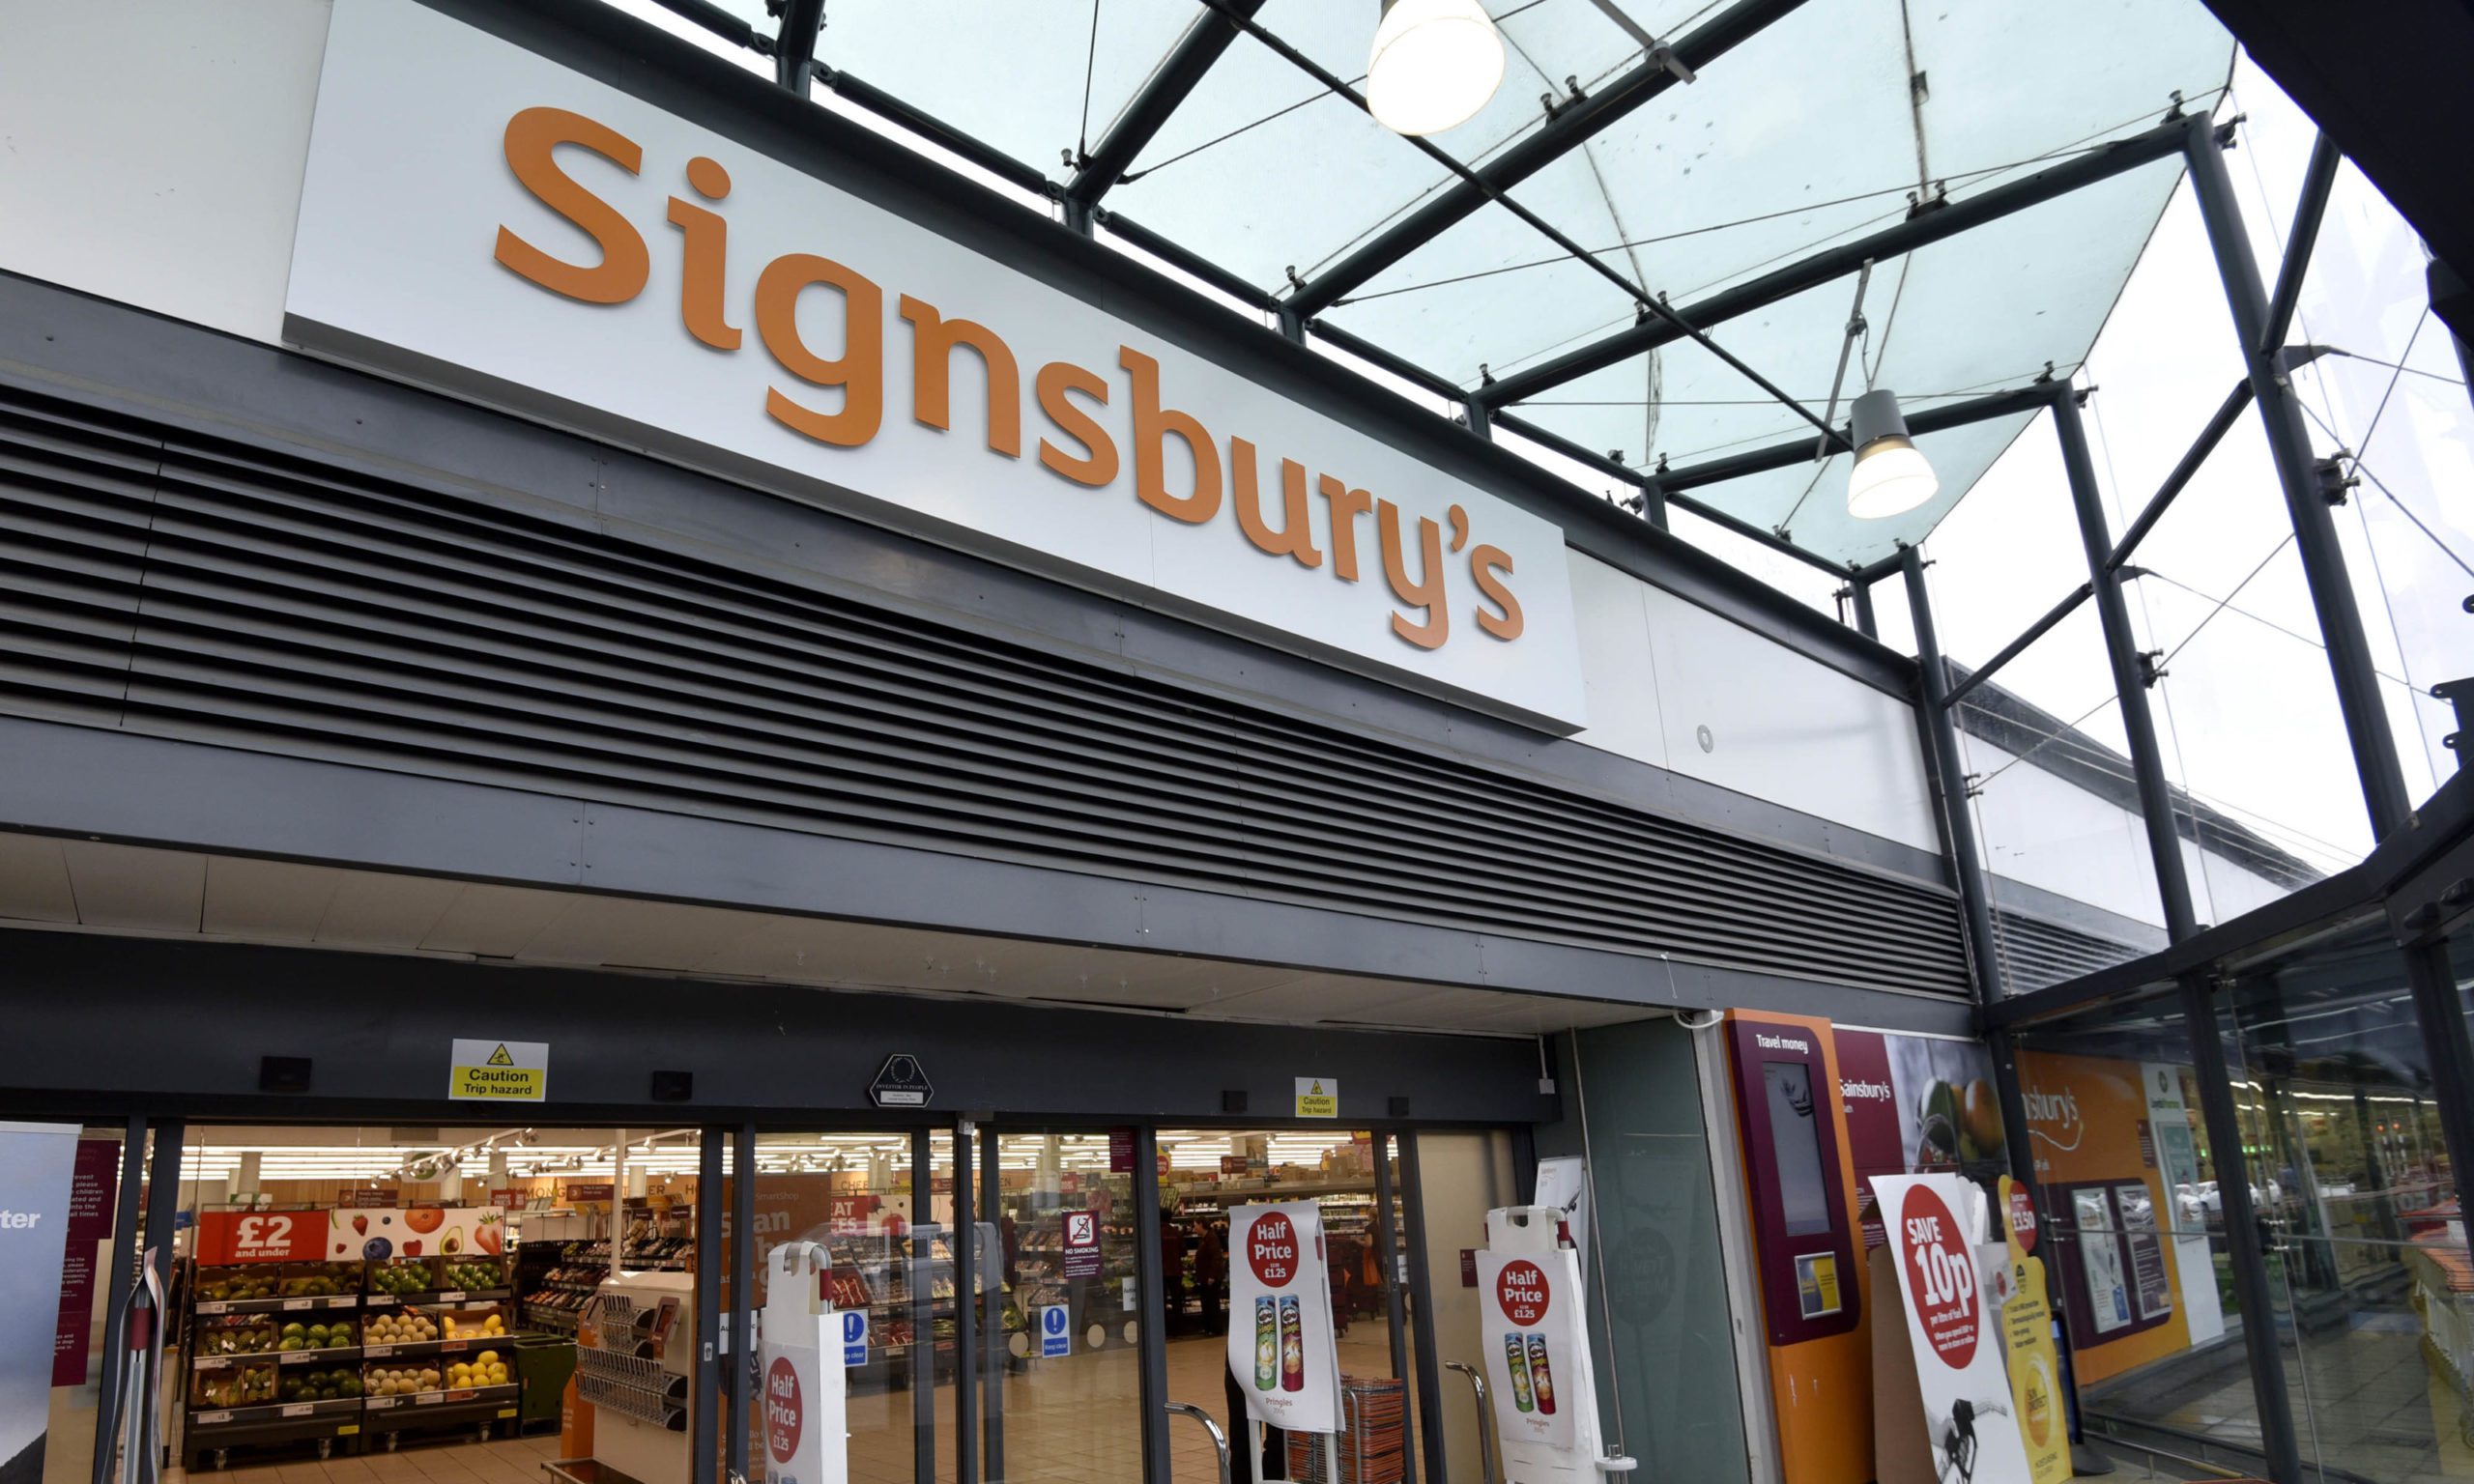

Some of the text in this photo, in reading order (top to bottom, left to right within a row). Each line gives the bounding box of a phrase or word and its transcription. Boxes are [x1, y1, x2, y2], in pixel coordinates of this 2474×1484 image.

[493, 104, 1525, 649] Signsbury's
[1755, 1034, 1809, 1054] Travel money
[469, 1069, 529, 1082] Caution
[464, 1083, 532, 1095] Trip hazard
[1303, 1097, 1331, 1105] Caution
[236, 1215, 293, 1248] £2
[1256, 1221, 1287, 1241] Half
[1907, 1215, 1943, 1245] SAVE
[235, 1247, 291, 1258] and under
[1074, 1245, 1100, 1254] SMOKING
[1253, 1241, 1292, 1260] Price
[1264, 1268, 1286, 1278] £1.25
[1506, 1270, 1538, 1285] Half
[1914, 1241, 1973, 1317] 10p
[1503, 1287, 1542, 1302] Price
[1514, 1309, 1536, 1319] £1.25
[771, 1374, 794, 1399] Half
[1265, 1397, 1293, 1408] Pringles
[768, 1399, 796, 1427] Price
[773, 1435, 790, 1451] £1.25
